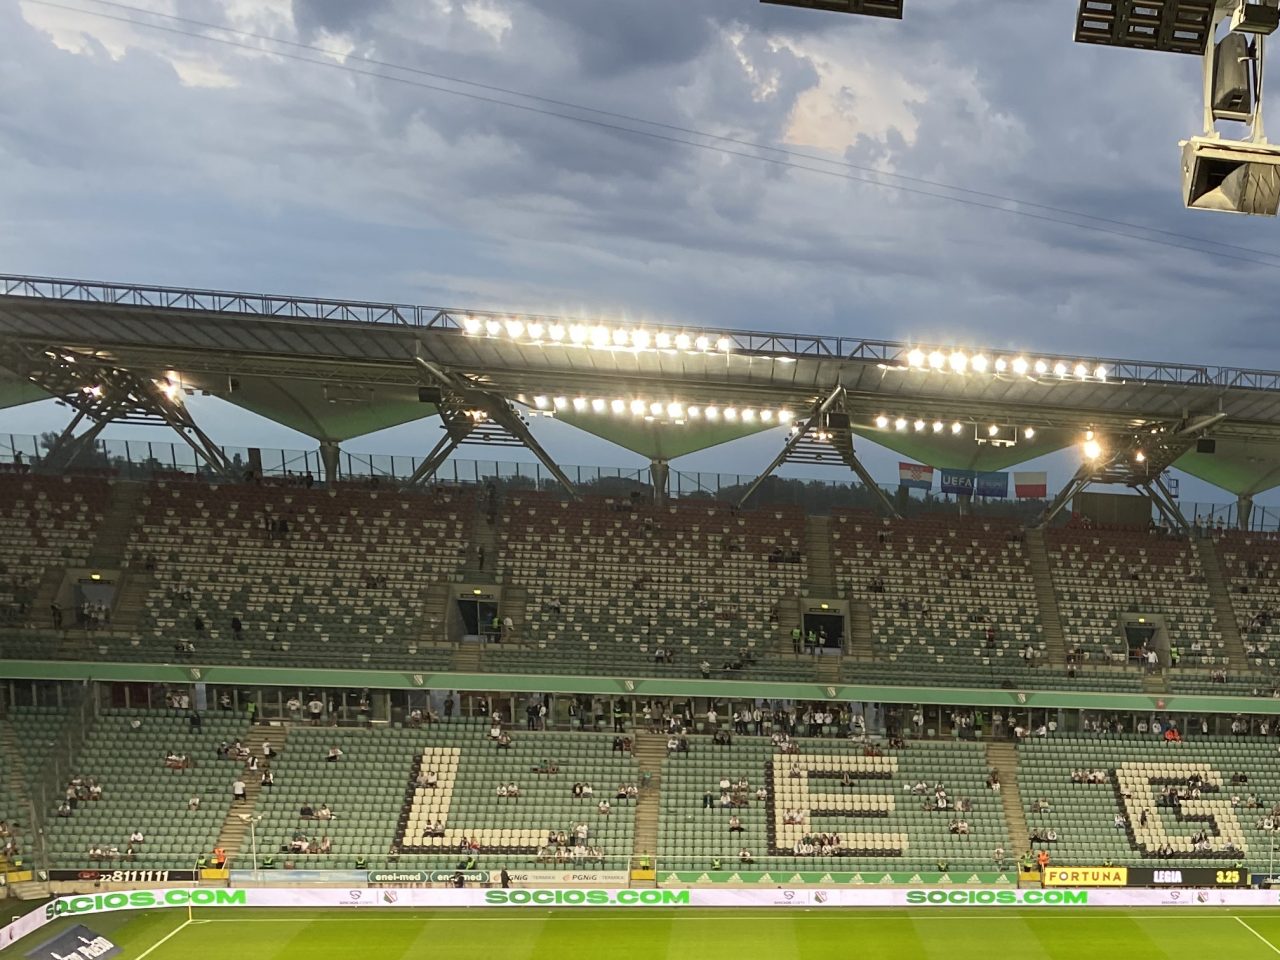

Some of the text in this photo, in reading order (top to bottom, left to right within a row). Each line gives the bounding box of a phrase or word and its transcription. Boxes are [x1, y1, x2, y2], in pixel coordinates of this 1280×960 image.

[942, 475, 972, 487] UEFA
[375, 872, 421, 881] enel-med
[1049, 871, 1122, 882] FORTUNA
[1153, 870, 1240, 883] LEGIA 3.25
[485, 890, 690, 904] SOCIOS.COM
[906, 890, 1088, 904] SOCIOS.COM
